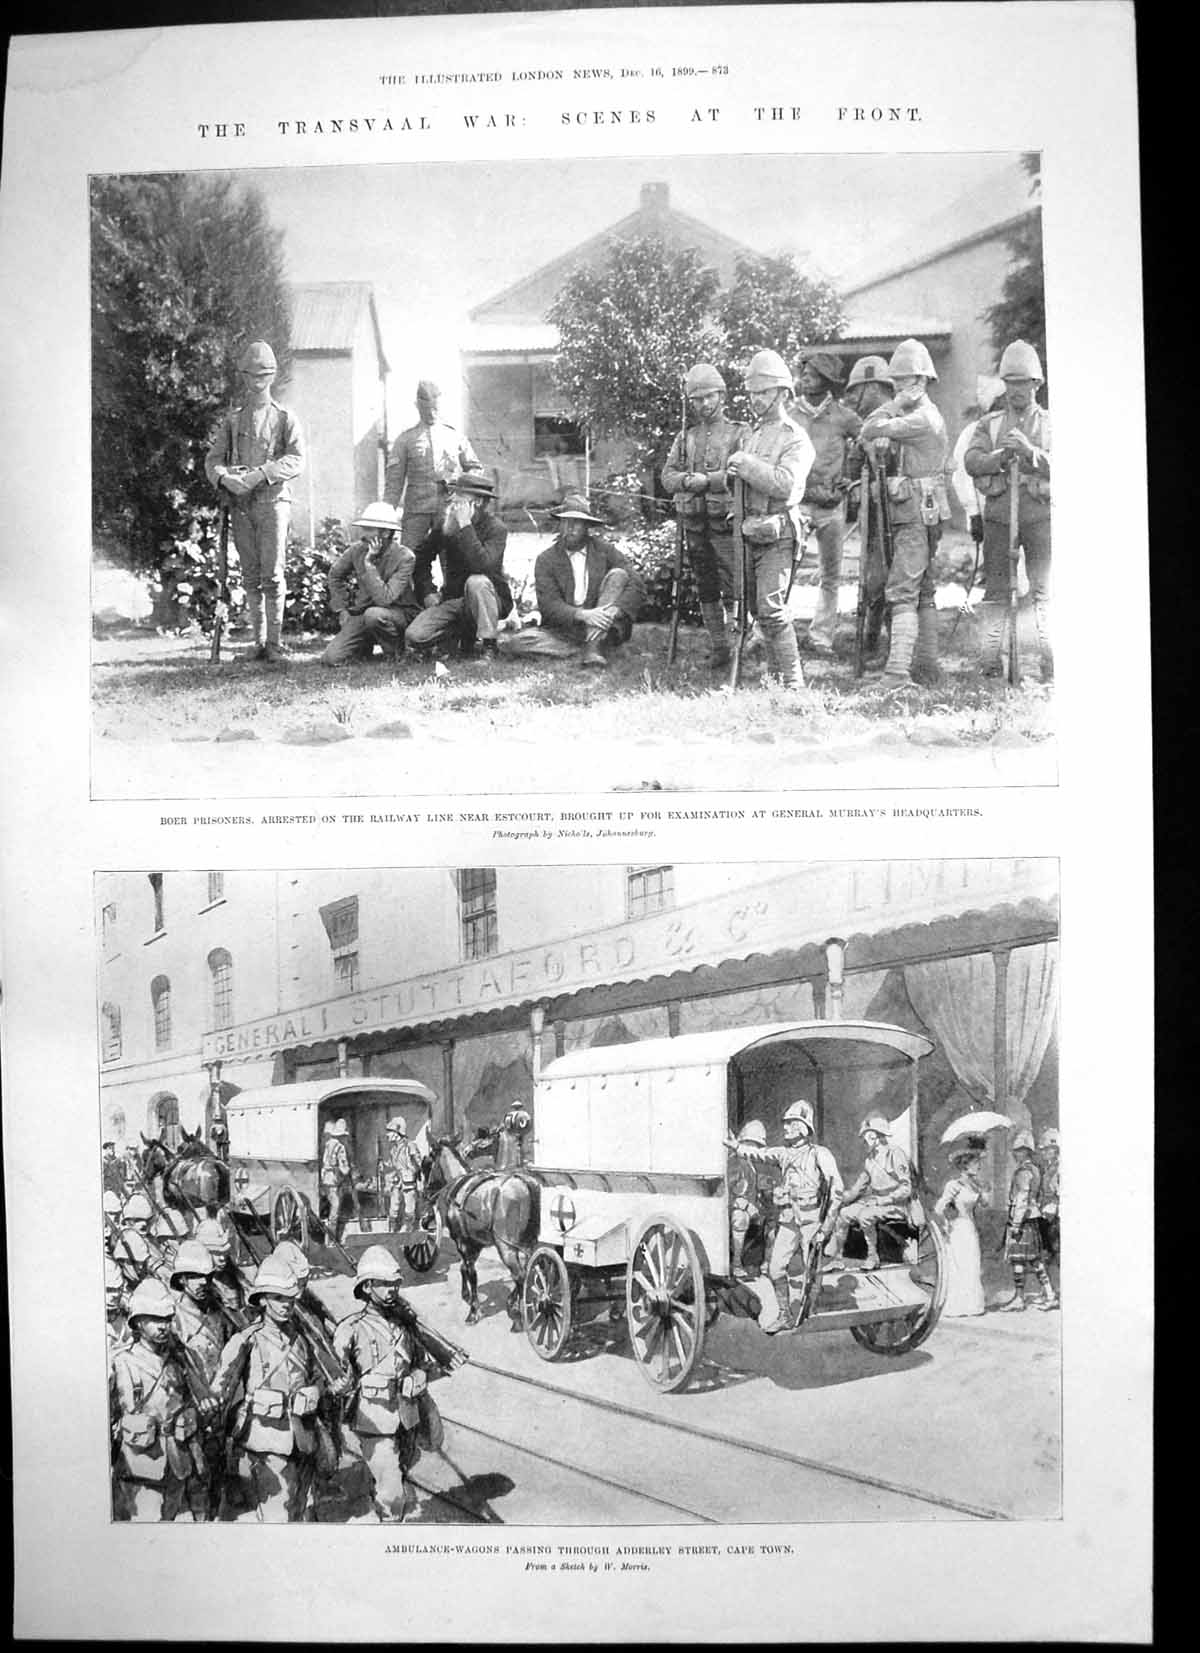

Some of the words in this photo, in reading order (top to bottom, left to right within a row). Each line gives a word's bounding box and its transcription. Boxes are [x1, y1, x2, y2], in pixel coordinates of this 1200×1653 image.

[378, 74, 406, 86] THE
[414, 71, 503, 86] ILLUSTRATED
[511, 69, 564, 82] LONDON
[572, 67, 614, 81] NEWS,
[650, 66, 665, 79] 16,
[197, 122, 246, 139] THE
[277, 116, 431, 137] TRANSVAAL
[463, 111, 527, 129] WAR:
[560, 109, 656, 126] SCENES
[690, 107, 721, 123] AT
[753, 106, 801, 121] THE
[837, 106, 923, 122] FRONT.
[159, 816, 188, 826] BOER
[260, 815, 317, 825] ARRESTED
[319, 814, 337, 825] ON
[341, 814, 365, 825] THE
[369, 813, 422, 825] RAILWAY
[426, 813, 454, 824] LINE
[459, 812, 490, 823] NEAR
[493, 812, 555, 825] ESTCOURT,
[559, 811, 614, 822] BROUGHT
[618, 811, 635, 822] UP
[639, 810, 662, 821] FOR
[667, 807, 745, 820] EXAMINATION
[751, 809, 767, 819] AT
[771, 808, 824, 819] GENERAL
[828, 807, 887, 819] MURRAY'S
[892, 807, 984, 820] HEADQUARTERS.
[491, 829, 540, 841] Photograph
[541, 829, 554, 840] by
[351, 936, 636, 1025] STUTTAFORD
[384, 1543, 500, 1555] AMBULANCE-WAGONS
[505, 1543, 552, 1556] PASSING
[556, 1543, 610, 1556] THROUGH
[615, 1543, 673, 1557] ADDERLEY
[677, 1545, 721, 1556] STREET,
[726, 1545, 756, 1556] CAPE
[759, 1543, 795, 1555] TOWN.
[524, 1561, 548, 1572] From
[550, 1563, 557, 1571] a
[559, 1561, 586, 1572] Sketch
[588, 1561, 599, 1574] by
[603, 1561, 617, 1572] W.
